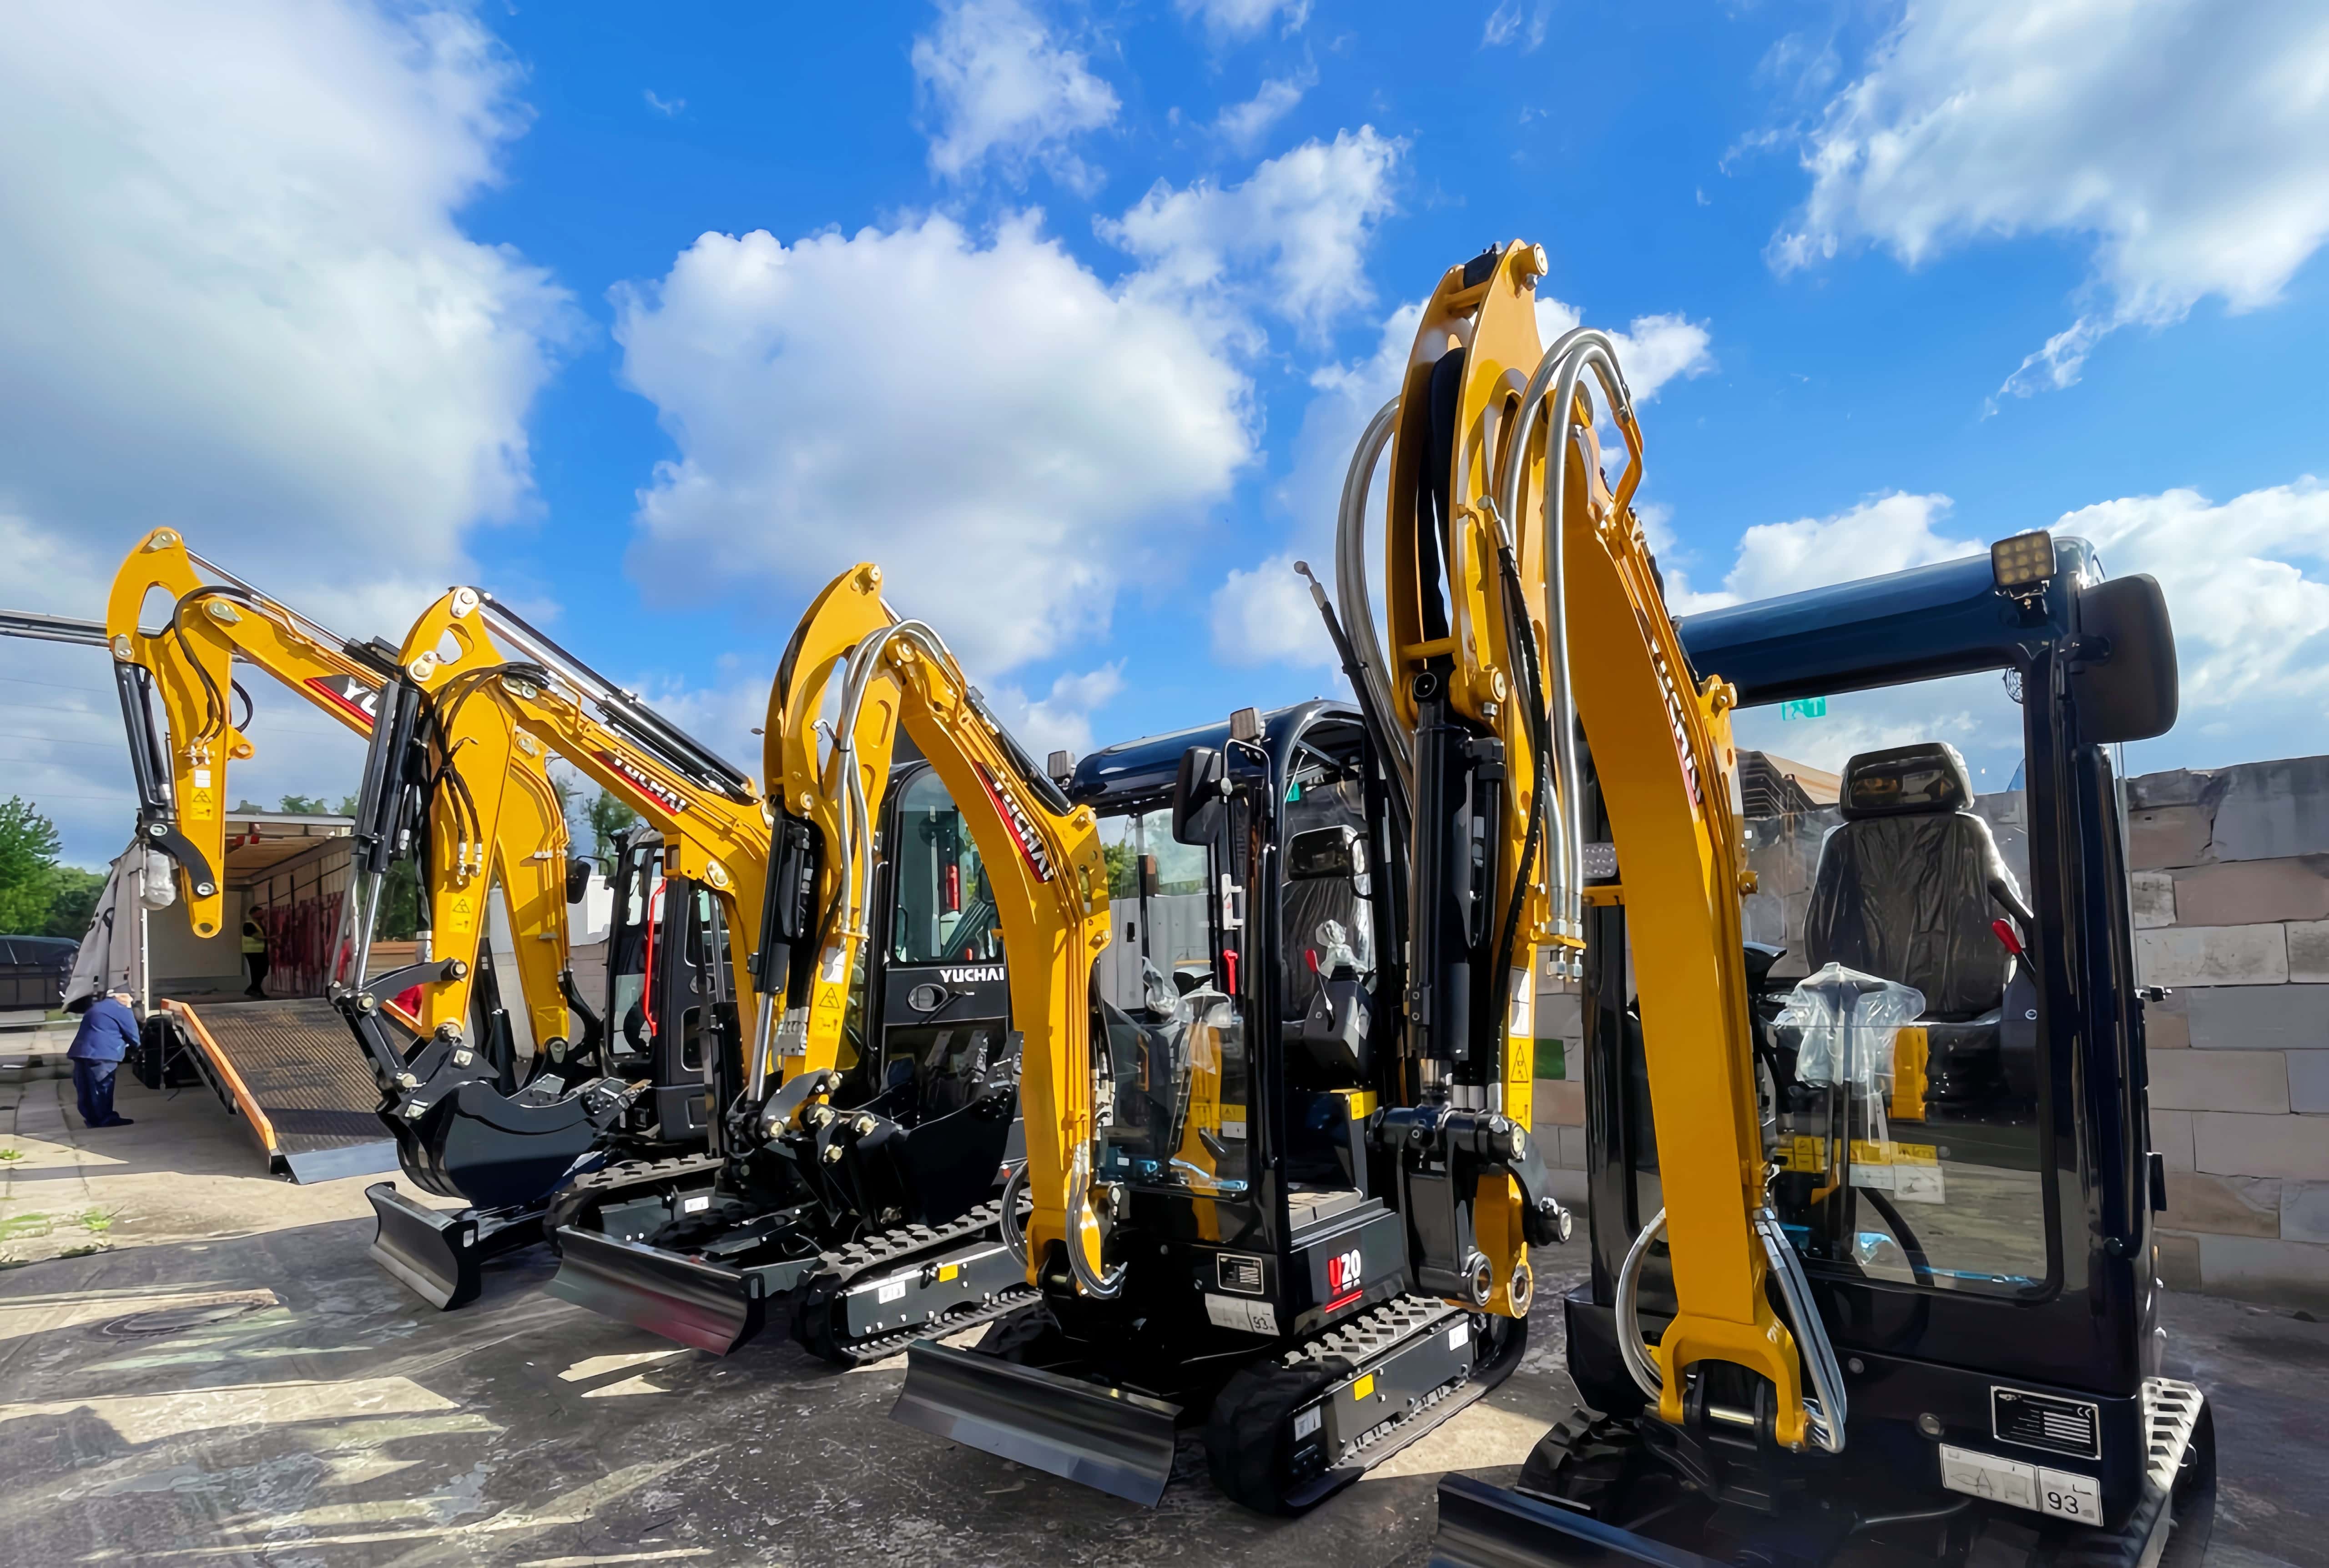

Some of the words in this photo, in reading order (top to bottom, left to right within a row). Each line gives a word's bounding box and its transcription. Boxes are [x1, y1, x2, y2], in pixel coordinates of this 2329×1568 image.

[939, 967, 1004, 983] YUCHAI
[1328, 1249, 1361, 1289] U20
[2047, 1492, 2079, 1514] 93
